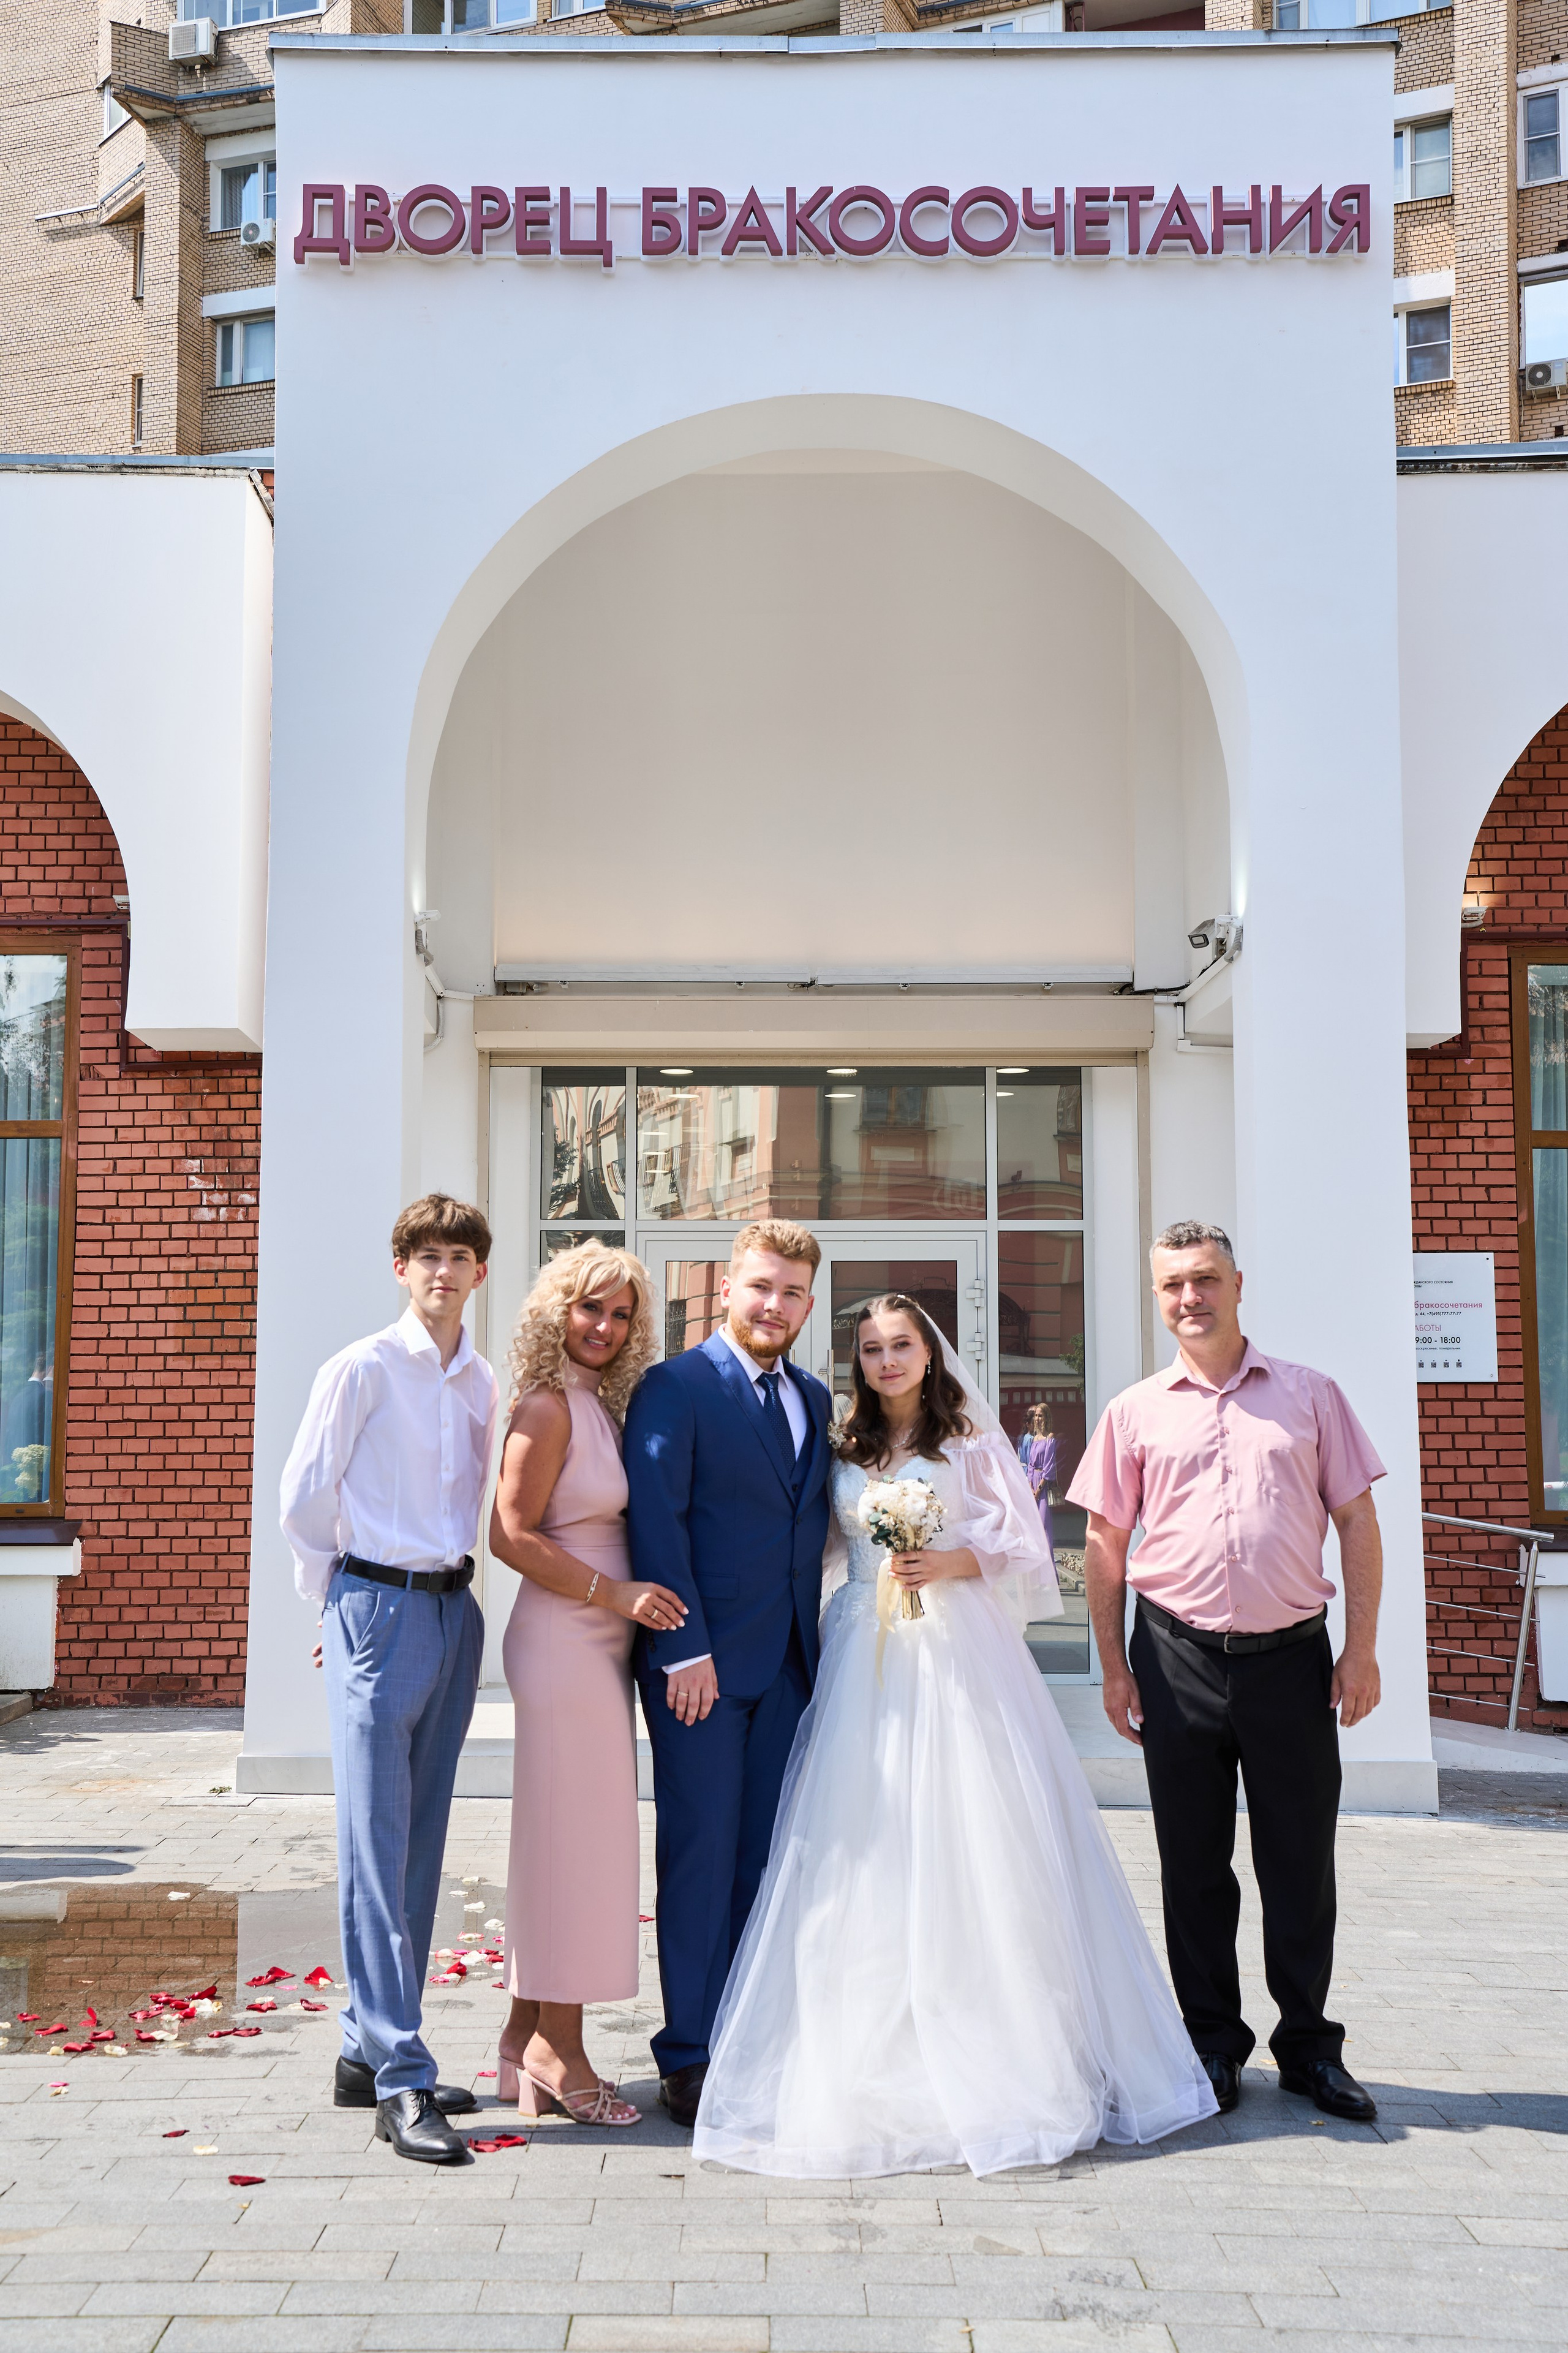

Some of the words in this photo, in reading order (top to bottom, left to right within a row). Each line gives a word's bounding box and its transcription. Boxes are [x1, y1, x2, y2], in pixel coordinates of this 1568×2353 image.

[294, 183, 613, 268] ДВОРЕЦ
[641, 183, 1371, 257] БРАКОСОЧЕТАНИЯ
[1414, 1301, 1482, 1310] бракосочетания
